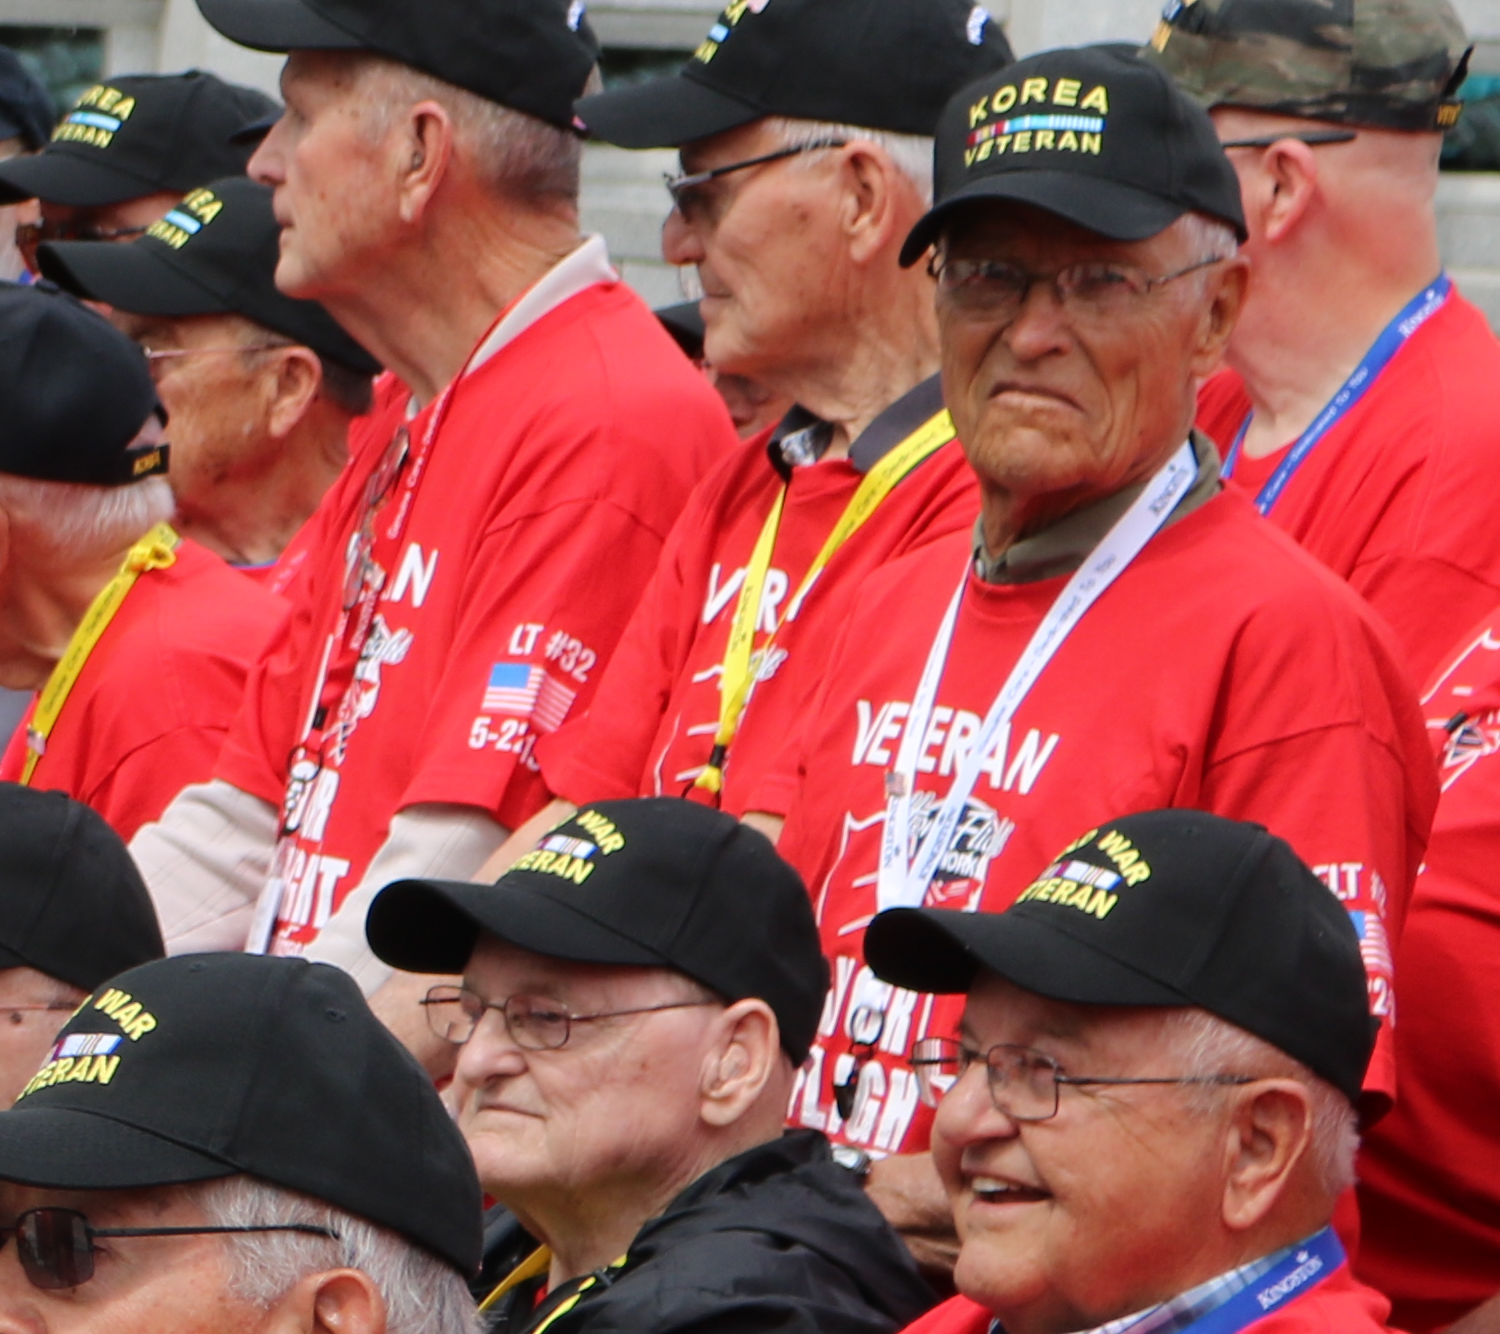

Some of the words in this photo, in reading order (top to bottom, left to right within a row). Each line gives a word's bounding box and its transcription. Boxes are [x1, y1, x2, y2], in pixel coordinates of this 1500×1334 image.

[76, 85, 138, 123] REA
[968, 75, 1112, 131] KOREA
[964, 129, 1103, 169] VETERAN
[508, 624, 545, 657] LT
[544, 630, 597, 684] #32
[850, 698, 1062, 796] VEERAN
[575, 808, 626, 857] WAR
[1095, 829, 1152, 889] WAR
[1014, 875, 1120, 921] TERAN
[92, 986, 159, 1043] WAR
[1256, 1253, 1324, 1312] KINGSTON
